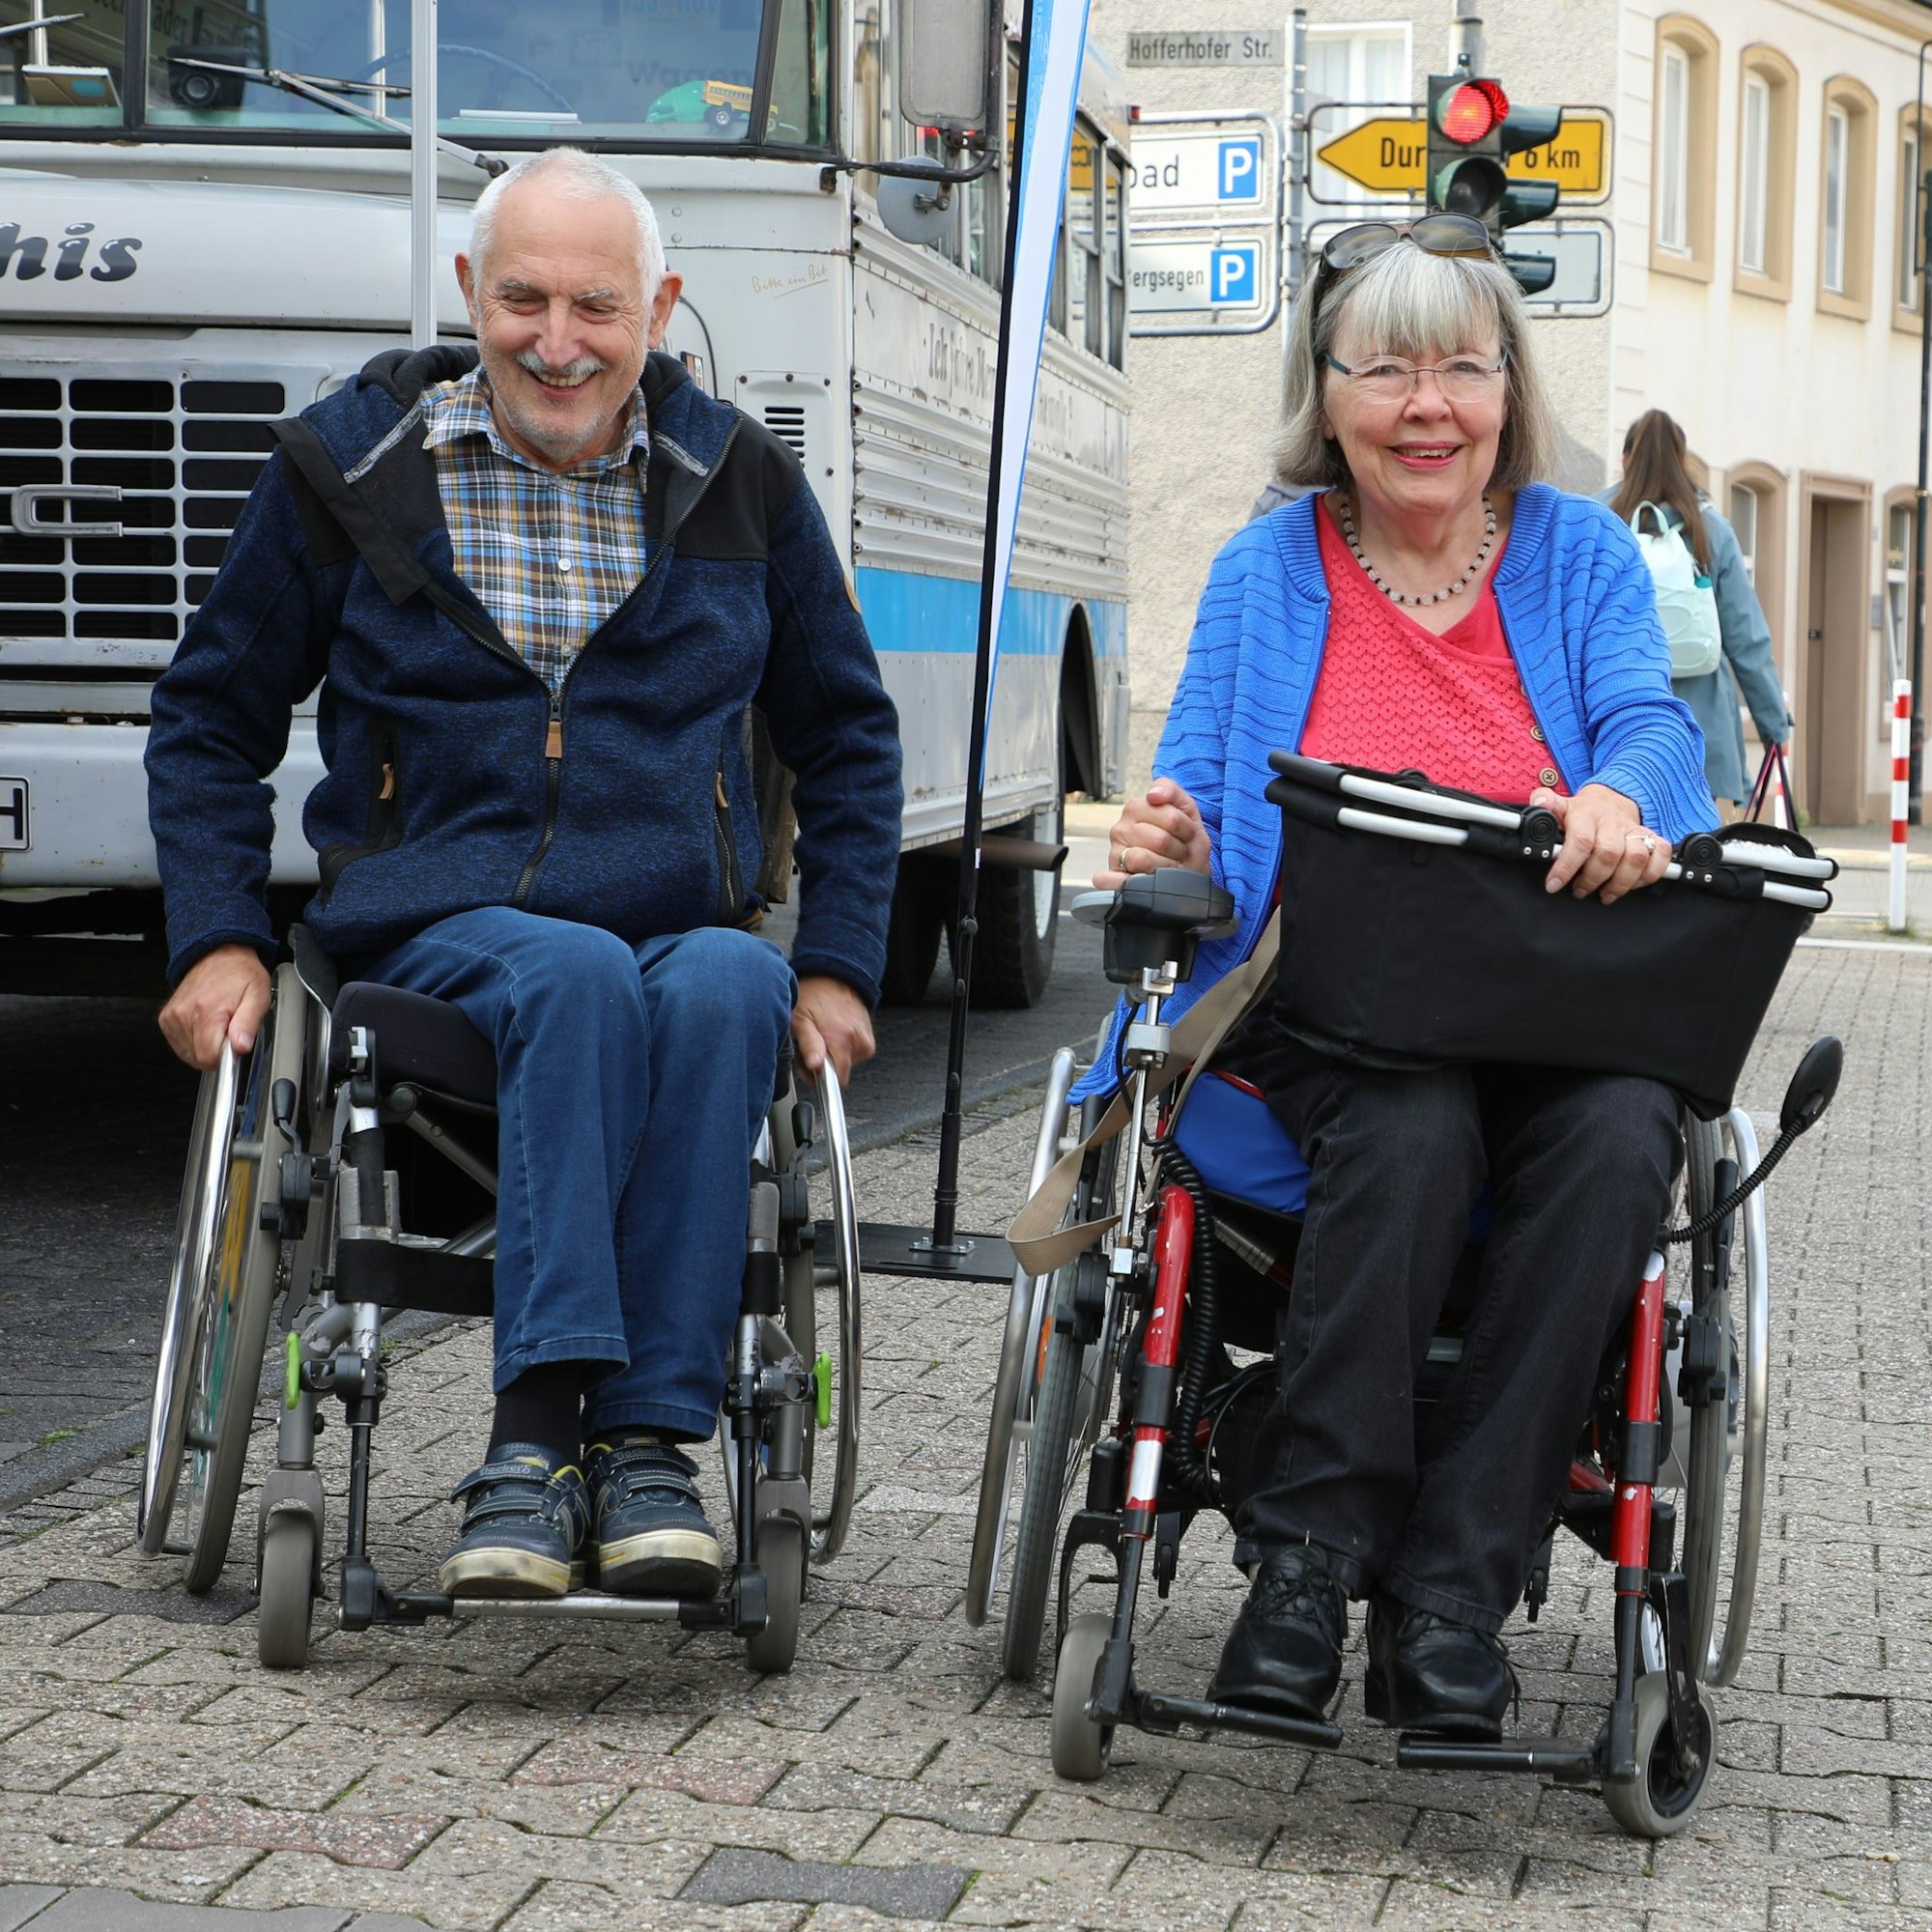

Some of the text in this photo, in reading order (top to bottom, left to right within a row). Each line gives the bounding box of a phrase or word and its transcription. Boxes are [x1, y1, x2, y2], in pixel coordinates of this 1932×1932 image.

[1129, 37, 1273, 60] Hofferhofer Str.
[1547, 142, 1581, 168] km
[1225, 147, 1253, 193] P
[1131, 254, 1246, 298] ergsegen P
[479, 1463, 531, 1476] Dockers
